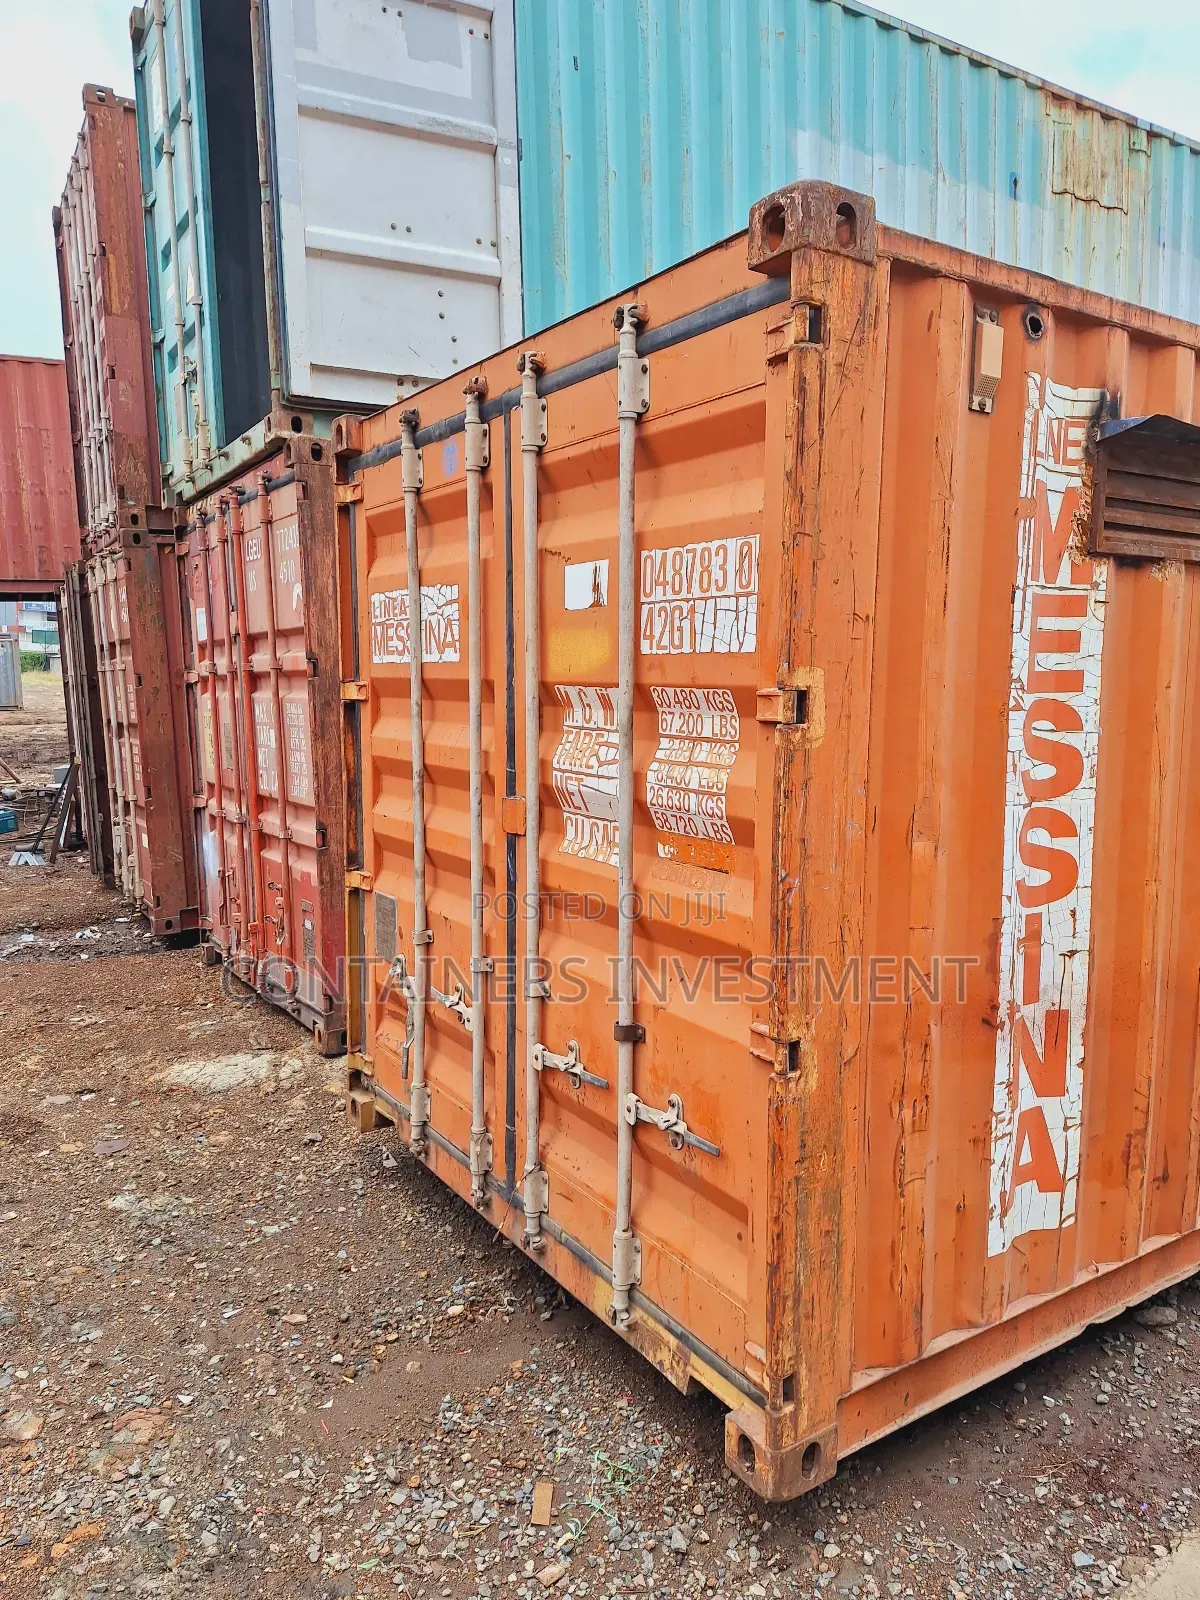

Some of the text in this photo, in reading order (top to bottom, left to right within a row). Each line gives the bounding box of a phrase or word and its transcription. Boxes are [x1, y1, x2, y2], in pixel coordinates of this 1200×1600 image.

[642, 544, 728, 598] 048783
[372, 596, 408, 620] LINEA
[642, 604, 695, 651] 42G1
[652, 687, 735, 713] 30.480 KGS
[660, 710, 738, 740] 67.200 LBS
[556, 729, 605, 770] TARE
[705, 741, 737, 766] KGS
[554, 773, 590, 813] NET
[656, 762, 727, 792] 8.480 LBS
[649, 785, 724, 821] 26.630 KGS
[653, 810, 733, 843] 58.720 LBS
[1004, 479, 1095, 1216] MESSINA
